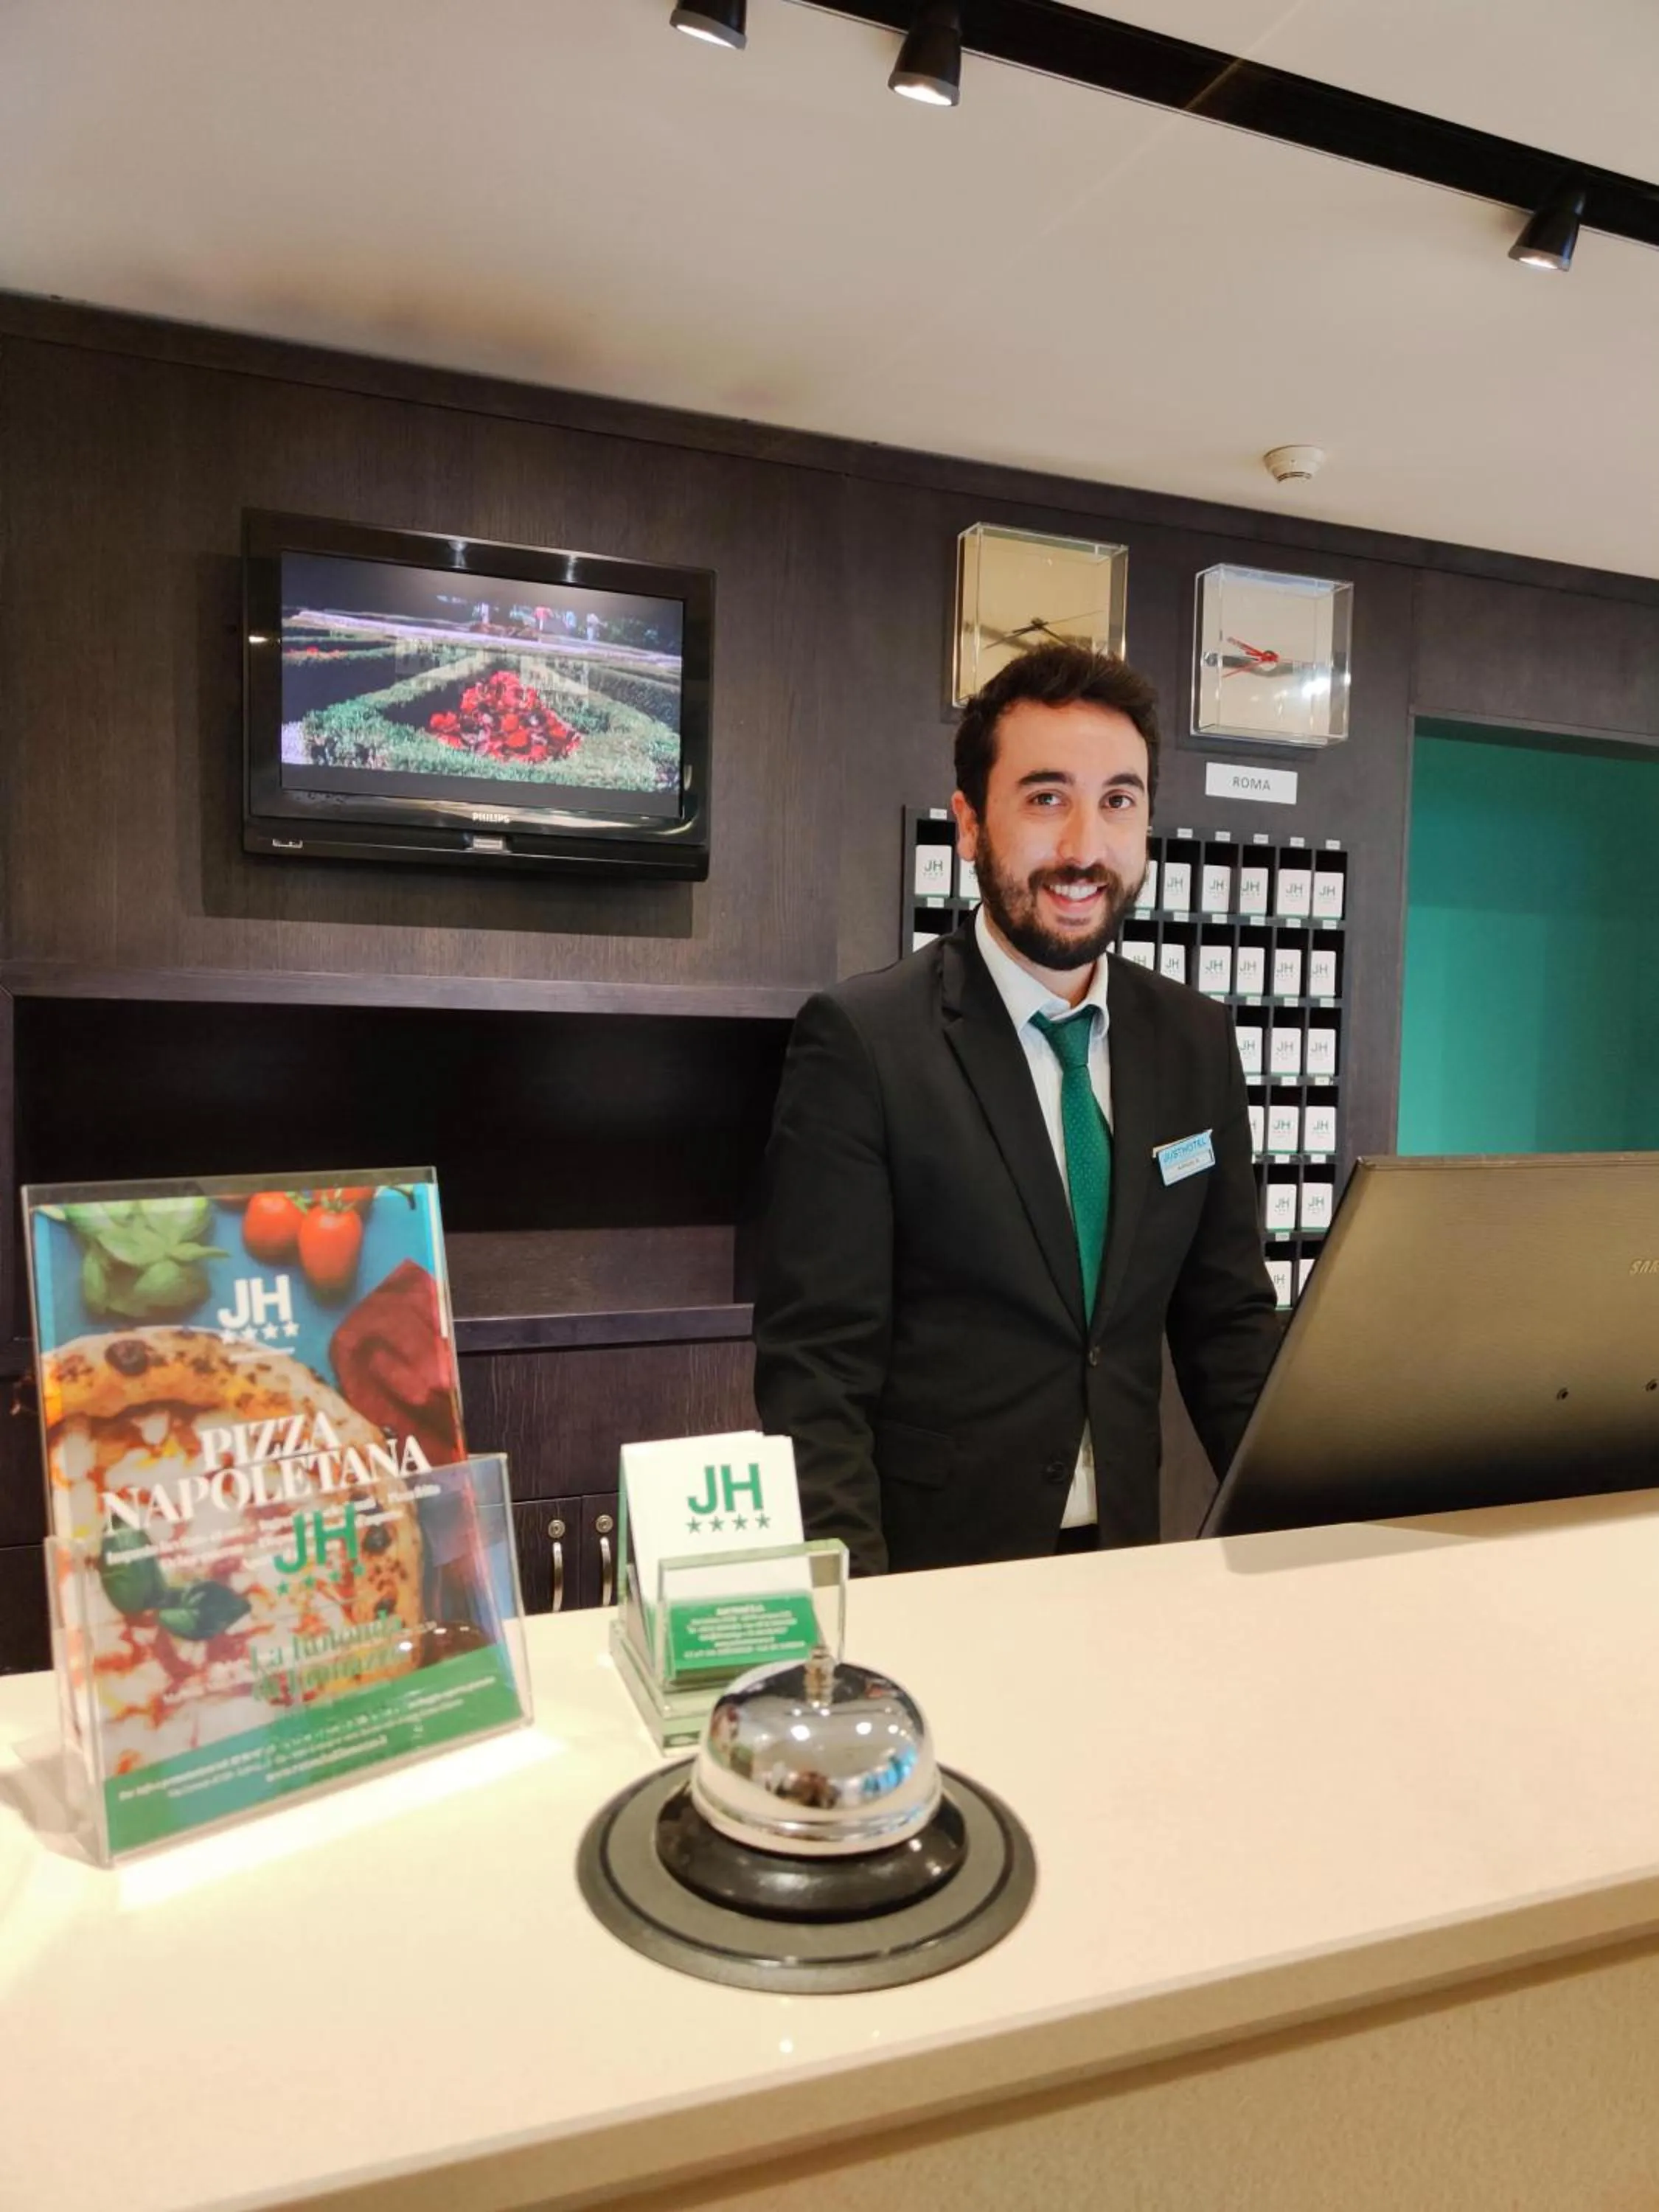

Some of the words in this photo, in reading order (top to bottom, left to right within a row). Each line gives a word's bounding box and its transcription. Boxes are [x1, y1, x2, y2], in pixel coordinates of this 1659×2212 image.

[1232, 776, 1271, 791] ROMA
[473, 812, 510, 824] PHILIPS
[924, 859, 944, 873] JH
[1166, 877, 1184, 889] JH
[1209, 880, 1225, 891] JH
[1241, 881, 1260, 892] JH
[1286, 883, 1304, 896] JH
[1319, 885, 1336, 897] JH
[1166, 958, 1180, 970] JH
[1205, 959, 1224, 973] JH
[1239, 960, 1257, 973] JH
[1276, 961, 1295, 974] JH
[1312, 963, 1328, 975] JH
[1239, 1040, 1256, 1051] JH
[1276, 1040, 1294, 1052] JH
[1310, 1041, 1328, 1052] JH
[1273, 1120, 1290, 1130] JH
[1313, 1119, 1329, 1130] JH
[1309, 1195, 1325, 1207] JH
[217, 1274, 293, 1329] JH
[199, 1411, 344, 1473] PIZZA
[101, 1434, 434, 1537] NAPOLETANA
[687, 1462, 764, 1515] JH
[274, 1503, 359, 1574] JH
